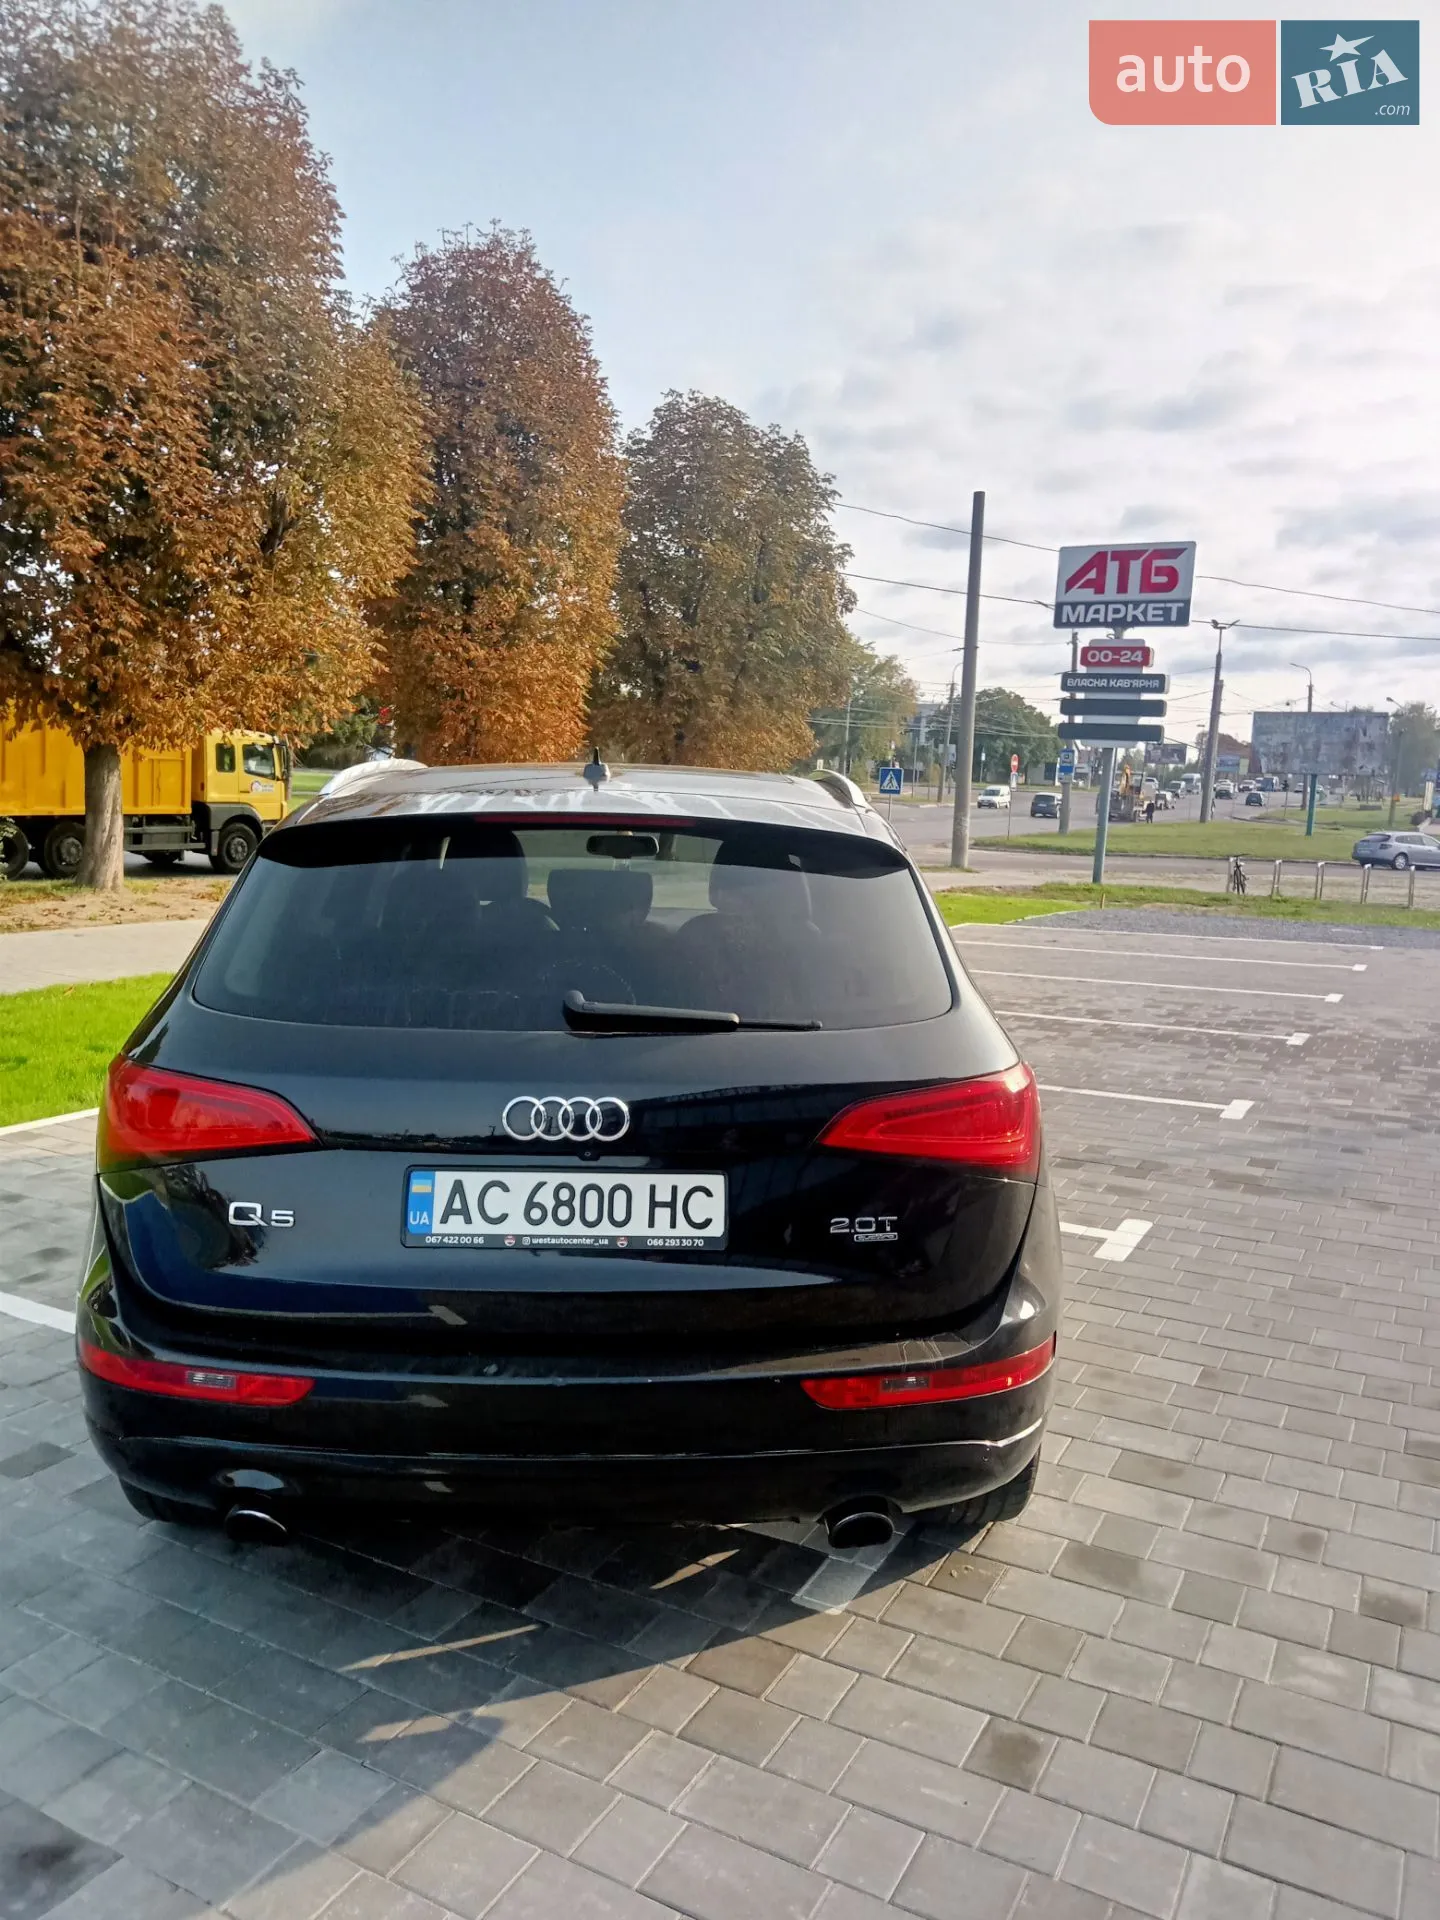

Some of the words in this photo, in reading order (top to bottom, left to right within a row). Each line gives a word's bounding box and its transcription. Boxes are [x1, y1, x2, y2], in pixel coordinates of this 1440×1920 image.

[1064, 547, 1188, 595] АТБ
[1061, 602, 1185, 623] МАРКЕТ
[1086, 650, 1144, 663] 00-24
[1066, 677, 1107, 688] ВЛАСНА
[439, 1178, 511, 1226] AC
[523, 1181, 633, 1229] 6800
[647, 1183, 714, 1230] HC
[228, 1201, 295, 1228] Q5
[409, 1211, 431, 1226] UA
[829, 1216, 898, 1234] 2.0T
[425, 1235, 441, 1244] 067
[442, 1235, 459, 1244] 422
[460, 1236, 472, 1244] 00
[531, 1237, 609, 1246] westautocenter_ua
[647, 1238, 664, 1247] 066
[664, 1238, 681, 1247] 293
[681, 1238, 692, 1247] 30
[693, 1238, 704, 1247] 70
